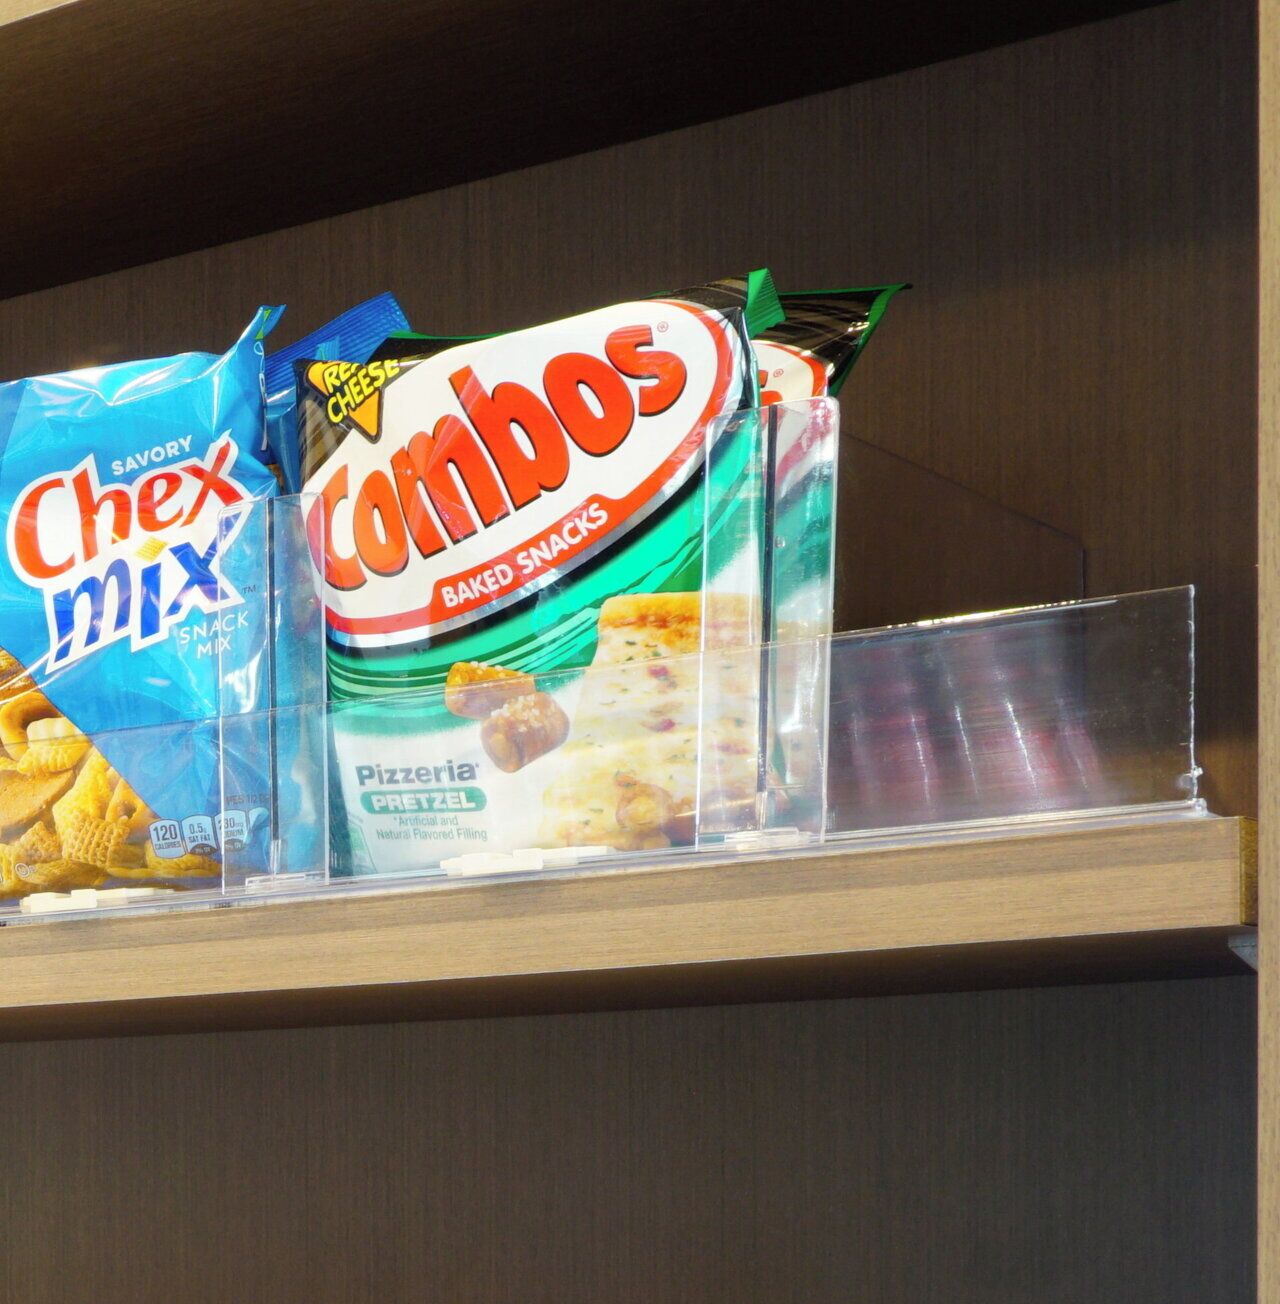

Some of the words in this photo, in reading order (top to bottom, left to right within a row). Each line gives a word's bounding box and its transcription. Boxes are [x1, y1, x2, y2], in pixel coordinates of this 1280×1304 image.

[328, 360, 399, 423] CHEESE
[112, 435, 193, 477] SAVORY
[307, 324, 688, 592] Combos
[11, 440, 244, 580] Chex
[440, 564, 514, 608] BAKED
[521, 502, 610, 575] SNACKS
[178, 610, 250, 646] SNACK
[195, 636, 232, 660] MIX
[371, 790, 477, 811] PRETZEL
[152, 824, 179, 841] 120
[376, 828, 411, 841] Natural
[413, 827, 455, 841] Flavored
[456, 827, 488, 842] Filling
[439, 815, 459, 826] and
